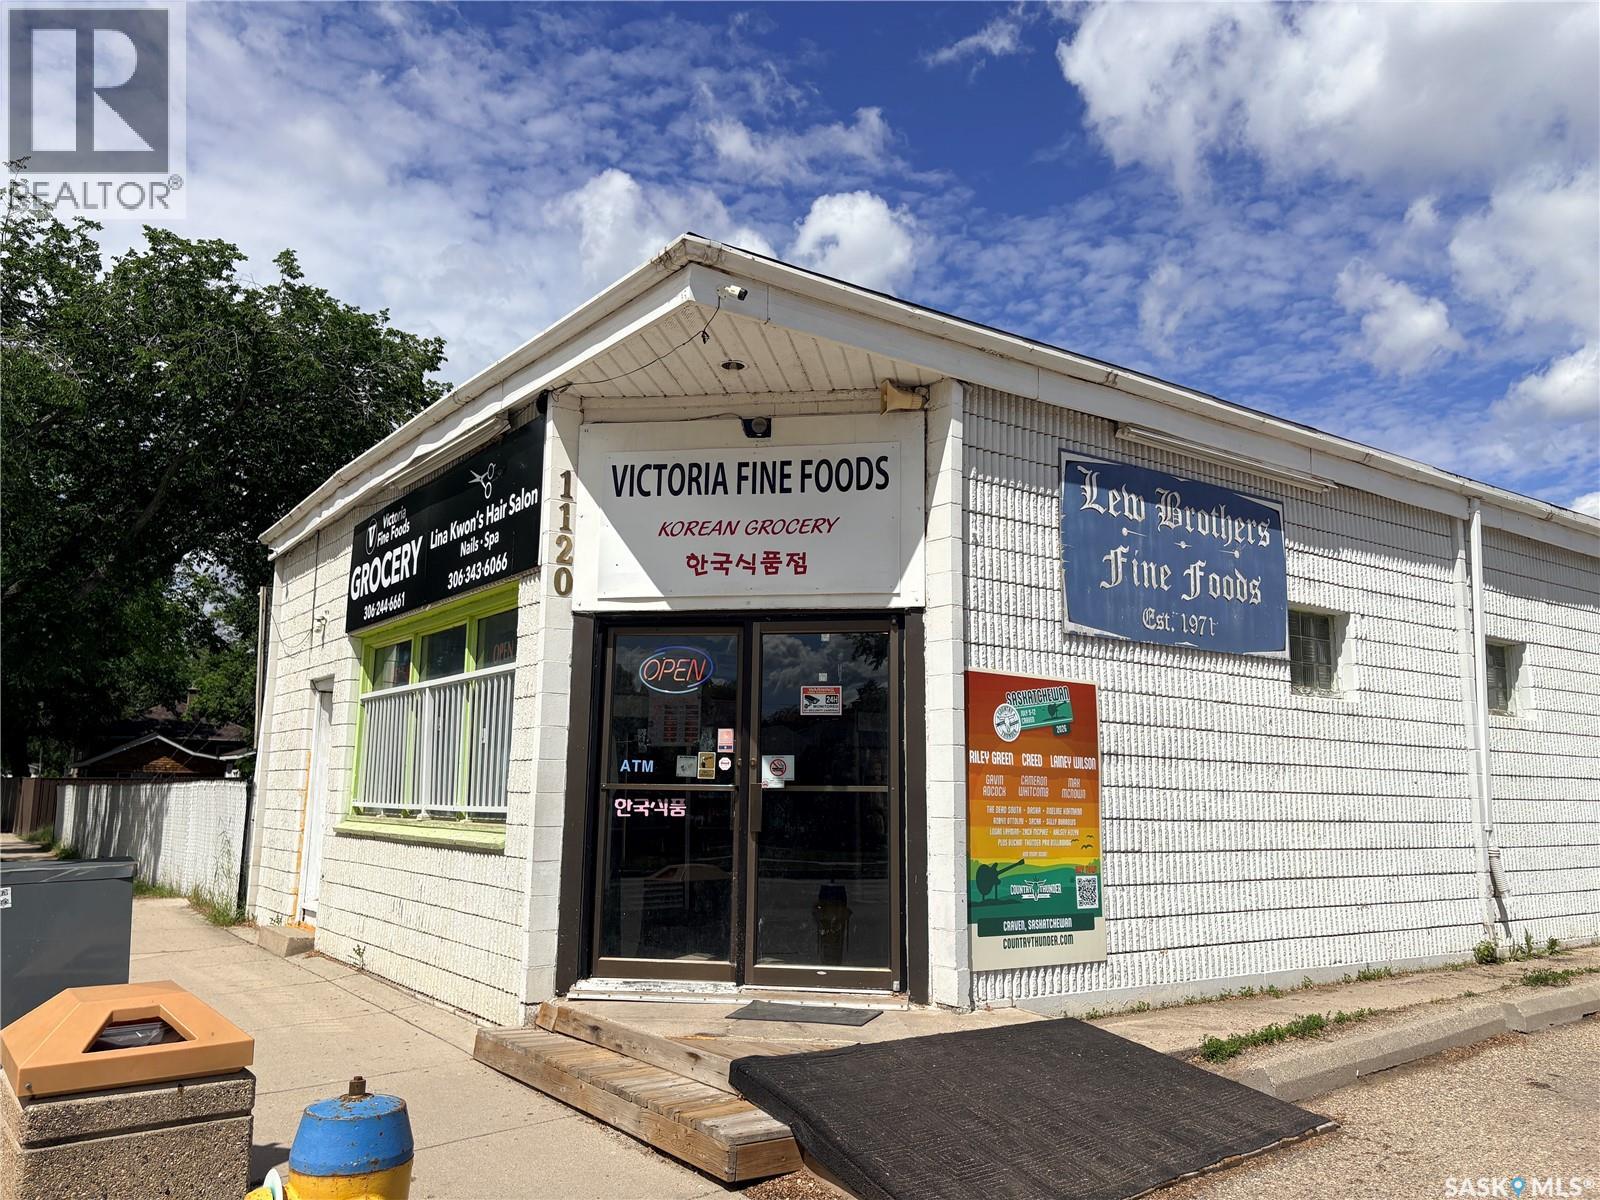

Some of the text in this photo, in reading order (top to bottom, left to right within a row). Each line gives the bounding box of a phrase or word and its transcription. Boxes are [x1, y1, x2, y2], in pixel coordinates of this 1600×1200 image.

[611, 456, 890, 498] VICTORIA FINE FOODS
[382, 505, 407, 526] Victoria
[1077, 465, 1271, 547] Lew Brothers
[430, 487, 539, 550] Lina Kwon's Hair Salon
[658, 516, 840, 537] KOREAN GROCERY
[376, 517, 411, 548] Fine Foods
[460, 531, 500, 557] Nails Spa
[350, 536, 423, 601] GROCERY
[686, 551, 808, 577] 한국식품점
[1100, 545, 1262, 605] Fine Foods
[1142, 607, 1174, 632] Est.
[643, 657, 707, 682] OPEN
[1006, 686, 1070, 706] SASKATCHEWAN
[620, 760, 654, 773] ATM
[969, 750, 1014, 766] RILEY GREEN
[1021, 753, 1043, 767] CREED
[1050, 754, 1097, 770] LAINEY WILSON
[1020, 775, 1048, 786] CAMERON
[1003, 917, 1073, 932] CRAVEN, SASKATCHEWAN
[1003, 934, 1074, 950] COUNTRYTHUNDER.COM
